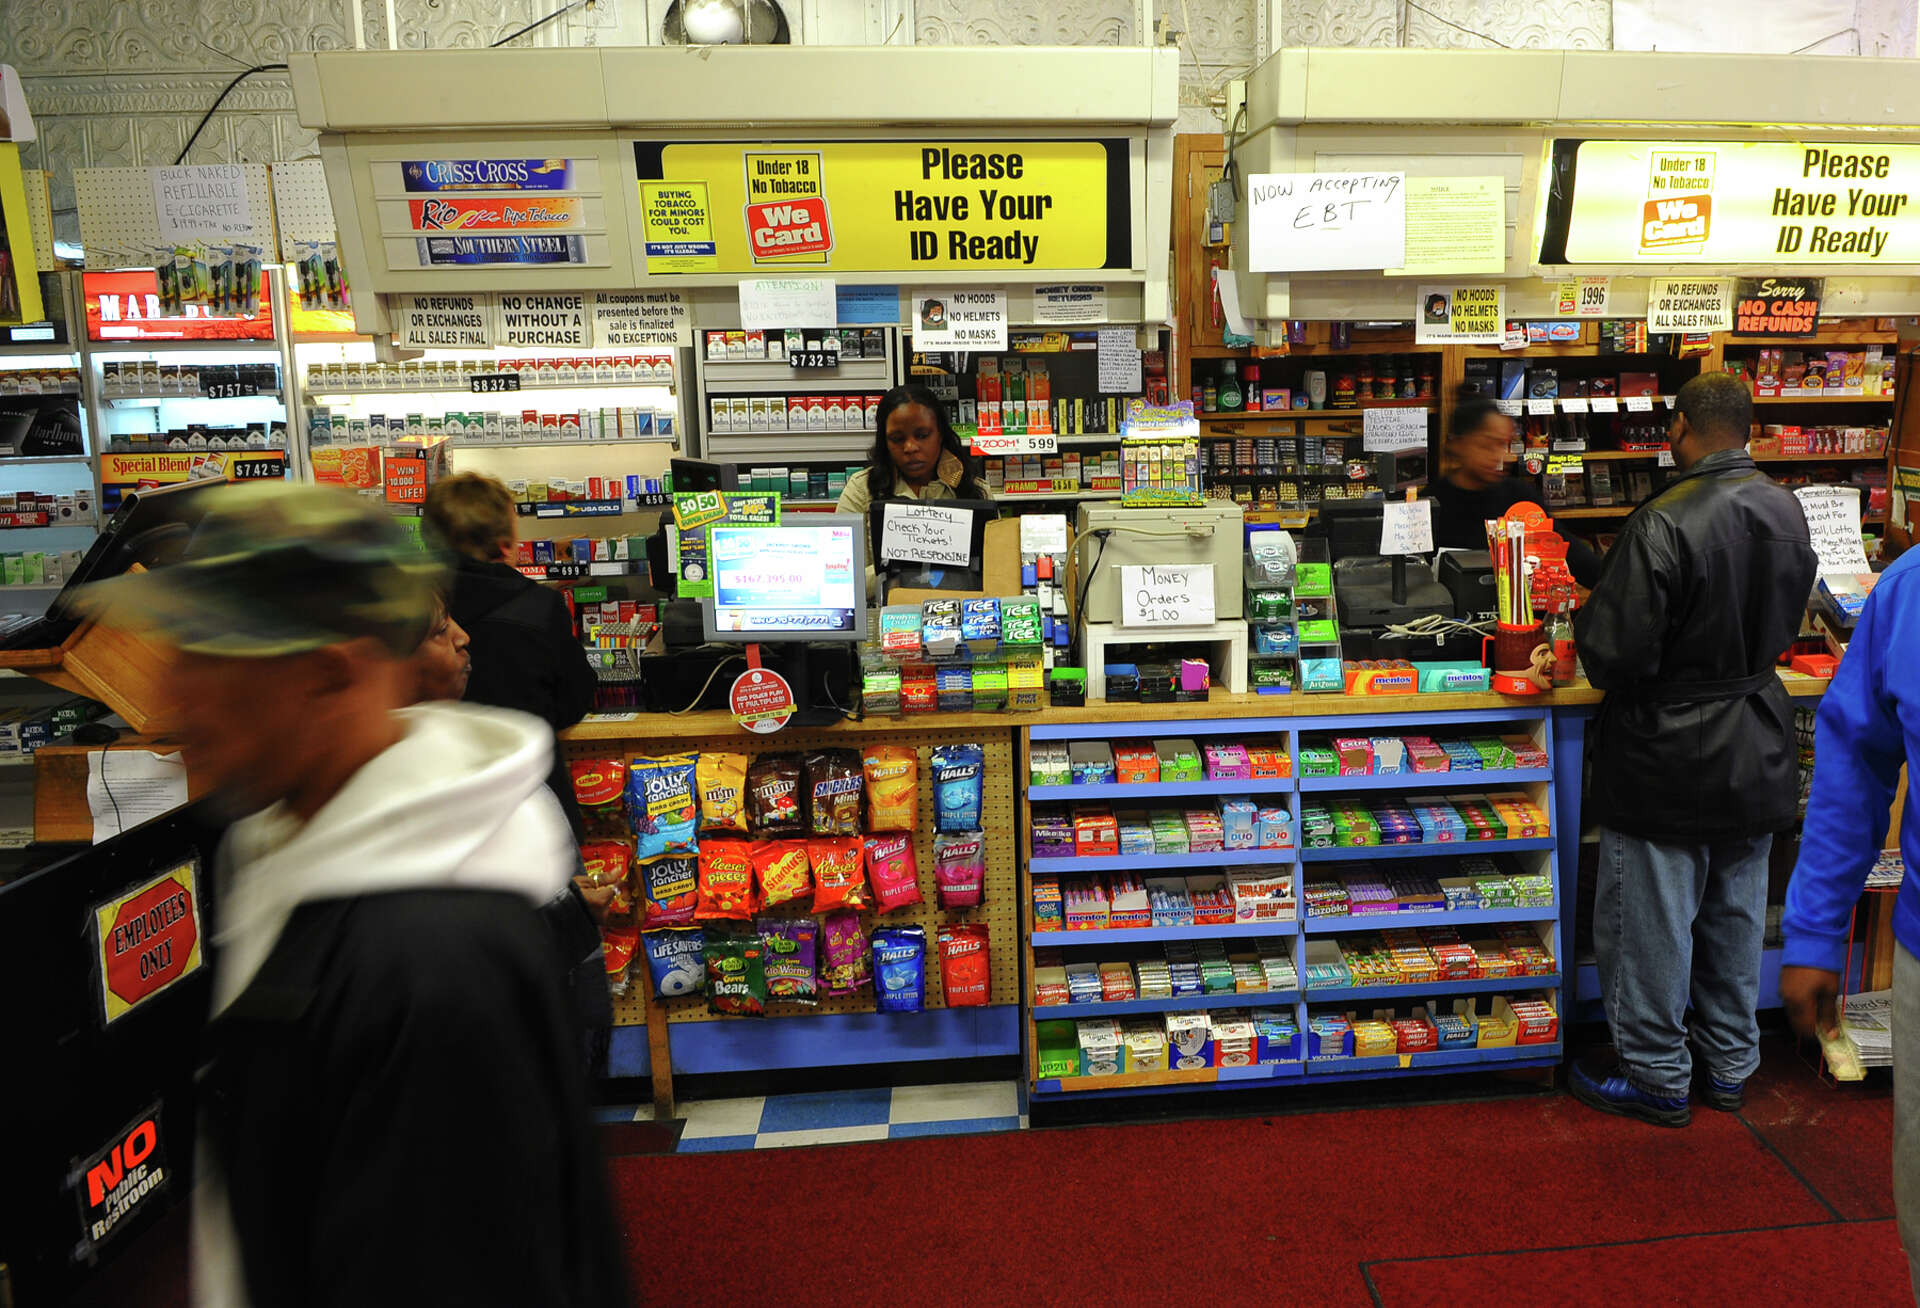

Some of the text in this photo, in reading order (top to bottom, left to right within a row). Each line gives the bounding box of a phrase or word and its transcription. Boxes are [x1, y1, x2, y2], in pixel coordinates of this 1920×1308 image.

[757, 160, 809, 176] Under 18
[922, 149, 1023, 179] Please
[1660, 158, 1705, 171] Under 18
[1804, 150, 1890, 178] Please
[161, 165, 240, 180] BUCK NAKED
[426, 160, 529, 183] CRISS-CROSS
[753, 178, 816, 193] No Tobacco
[1653, 176, 1709, 189] No Tobacco
[164, 182, 238, 199] REFILLABLE
[1254, 182, 1293, 204] NOW
[895, 190, 1052, 221] Have Your
[1772, 188, 1908, 216] Have Your
[422, 200, 569, 229] Rio Pipe Tobacco
[765, 205, 809, 226] We
[1294, 201, 1371, 228] EBT
[1656, 200, 1698, 222] We
[1645, 216, 1705, 240] Card
[755, 224, 822, 247] Card
[1777, 227, 1888, 257] ID Ready
[454, 237, 520, 254] SOUTHERN
[522, 236, 566, 253] STEEL
[911, 230, 1038, 264] ID Ready
[1035, 286, 1069, 294] MONEY
[1457, 289, 1495, 300] NO HOODS
[1582, 287, 1605, 304] 1996
[1667, 284, 1718, 295] NO REFUNDS
[1758, 280, 1805, 301] Sorry
[415, 298, 473, 309] NO REFUNDS
[503, 297, 582, 309] NO CHANGE
[596, 293, 680, 304] All coupons must be
[954, 294, 995, 303] NO HOODS
[1659, 299, 1721, 311] OR EXCHANGES
[598, 306, 684, 319] presented before the
[1452, 305, 1498, 316] NO HELMETS
[1738, 301, 1816, 316] NO CASH
[412, 314, 482, 326] OR EXCHANGES
[506, 315, 581, 326] WITHOUT A
[950, 312, 1000, 321] NO HELMETS
[1655, 314, 1724, 327] ALL SALES FINAL
[610, 320, 674, 330] sale is finalized
[1455, 321, 1494, 332] NO MASKS
[1738, 317, 1812, 332] REFUNDS
[409, 332, 486, 344] ALL SALES FINAL
[509, 332, 581, 343] PURCHASE
[608, 332, 677, 344] NO EXCEPTIONS
[955, 330, 996, 339] NO MASKS
[912, 353, 926, 364] #1
[982, 440, 1015, 448] ZOOM
[113, 457, 191, 475] Special Blend
[397, 467, 414, 475] WIN
[400, 488, 423, 498] LIFE!
[1006, 482, 1038, 492] PYRAMID
[680, 499, 696, 514] 50
[700, 495, 716, 507] 50
[906, 506, 953, 522] Lottery
[888, 521, 944, 535] Check Your
[887, 548, 968, 563] NOT RESPONSIBLE
[1137, 590, 1190, 606] Orders
[928, 601, 954, 612] ICE
[968, 601, 993, 611] ICE
[1007, 606, 1032, 616] ICE
[1139, 610, 1179, 622] $1.00
[1009, 630, 1035, 639] ICE
[1375, 676, 1411, 684] mentos
[1447, 674, 1483, 682] mentos
[873, 765, 906, 777] HALLS
[940, 766, 975, 780] HALLS
[644, 775, 684, 795] JOLLY
[815, 776, 862, 797] SNICKERS
[648, 786, 688, 803] rancher
[1231, 832, 1252, 841] DUO
[1265, 832, 1288, 840] DUO
[875, 840, 906, 857] HALLS
[942, 843, 976, 858] HALLS
[651, 860, 688, 877] JOLLY
[653, 870, 693, 887] rancher
[708, 872, 747, 885] pieces
[1154, 910, 1192, 918] mentos
[1257, 910, 1278, 918] CHEW
[1308, 903, 1348, 917] Bazooka
[114, 891, 186, 956] EMPLOYEES
[654, 941, 703, 958] LIFE SAVERS
[881, 948, 915, 960] HALLS
[947, 941, 980, 956] HALLS
[140, 937, 173, 981] ONLY
[715, 981, 749, 994] Bears
[1446, 1031, 1470, 1040] HALLS
[1525, 1026, 1549, 1034] HALLS
[87, 1120, 156, 1208] NO
[106, 1164, 146, 1213] Public
[92, 1168, 164, 1240] Restroom
